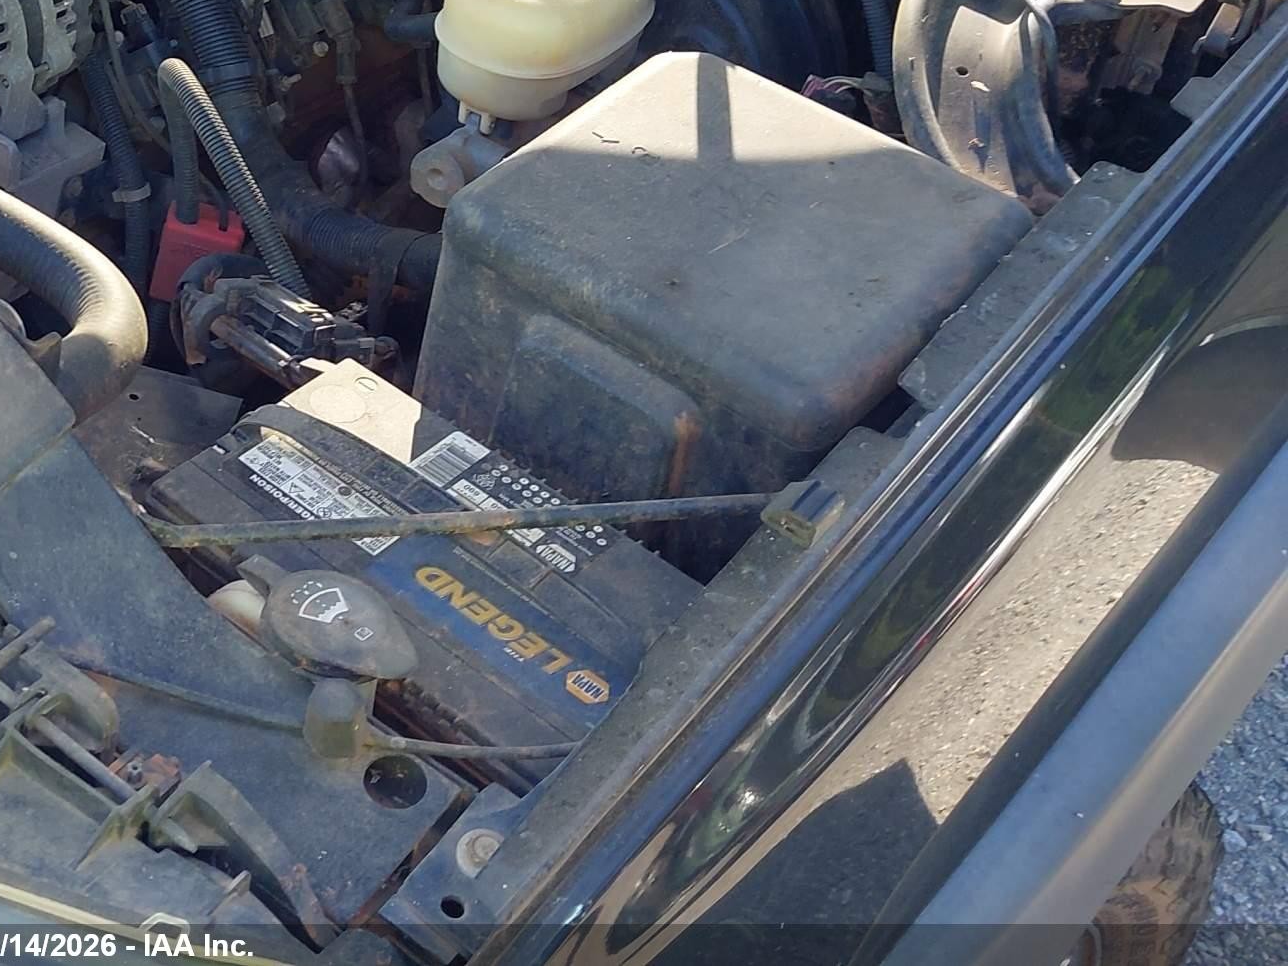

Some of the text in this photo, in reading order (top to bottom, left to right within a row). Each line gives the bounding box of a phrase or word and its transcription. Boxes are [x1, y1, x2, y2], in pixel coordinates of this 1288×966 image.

[541, 544, 573, 573] NAPA
[414, 566, 605, 701] NAPA LEGEND
